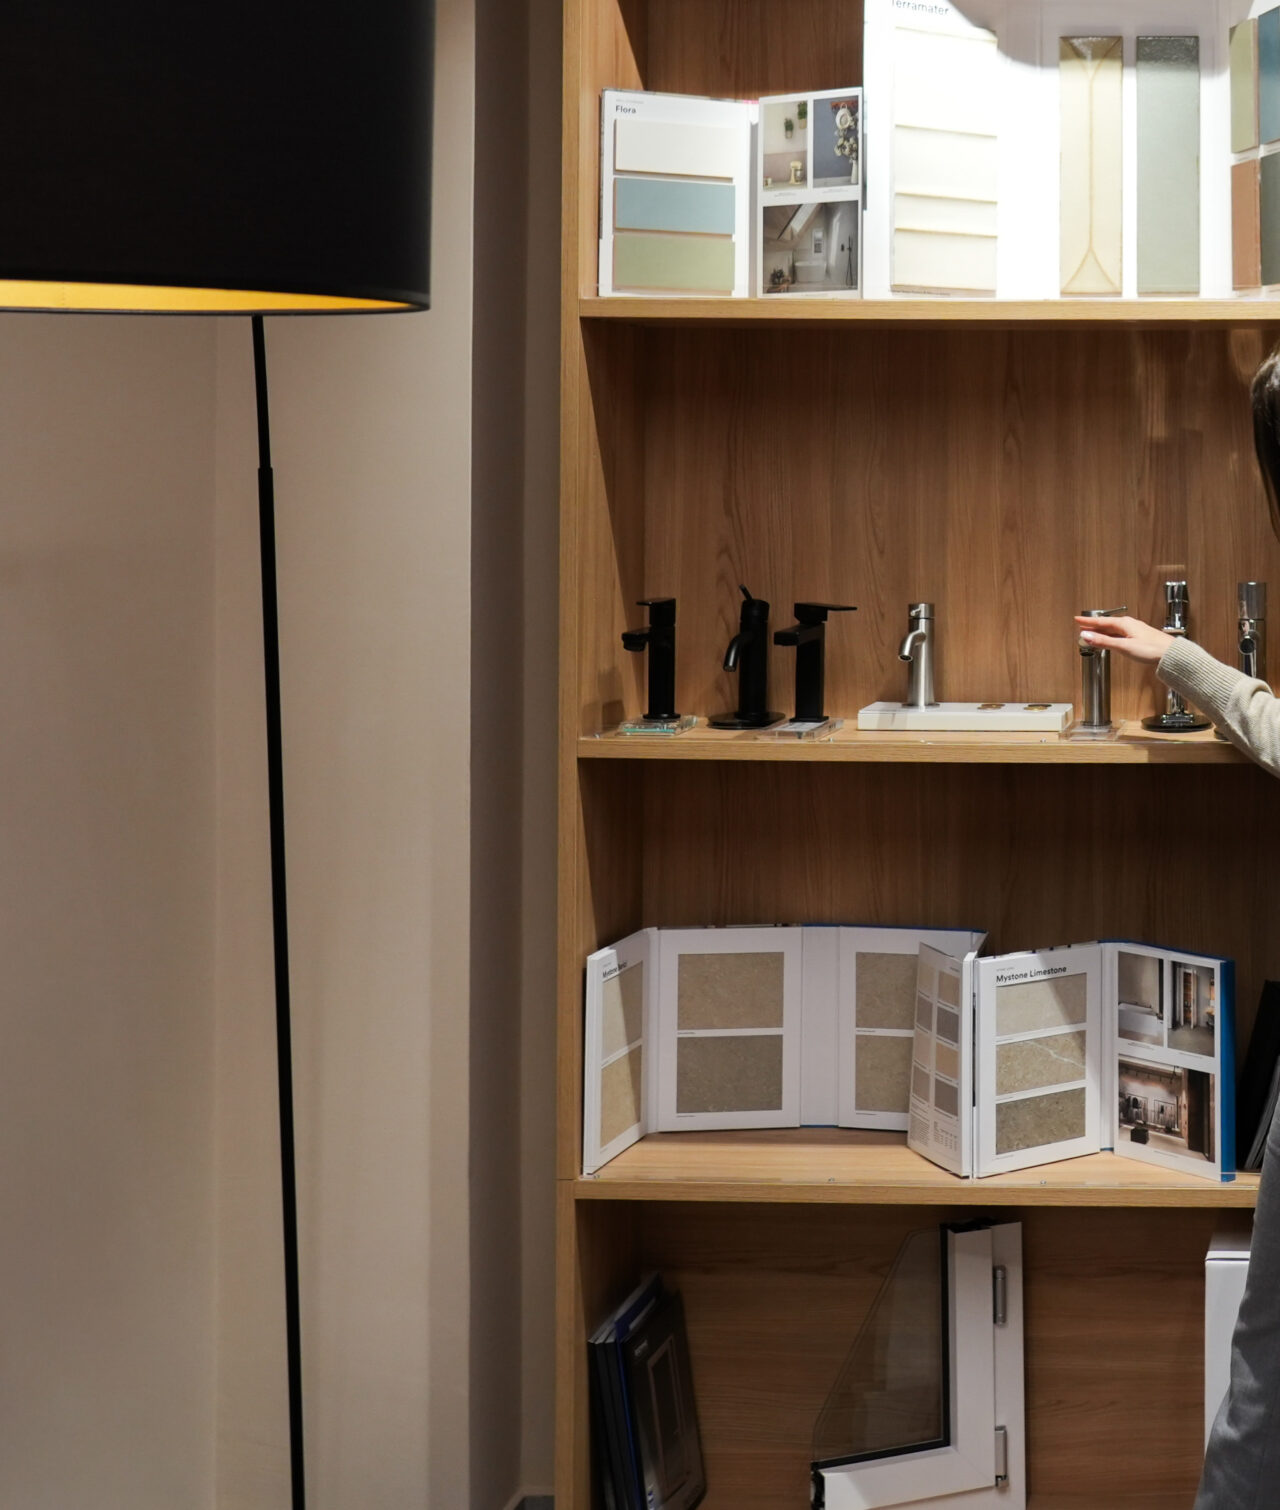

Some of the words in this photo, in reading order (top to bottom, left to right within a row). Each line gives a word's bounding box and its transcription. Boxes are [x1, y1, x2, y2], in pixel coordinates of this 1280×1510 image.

[616, 105, 637, 114] Flora
[996, 972, 1028, 983] Mystone
[1029, 967, 1067, 978] Limestone
